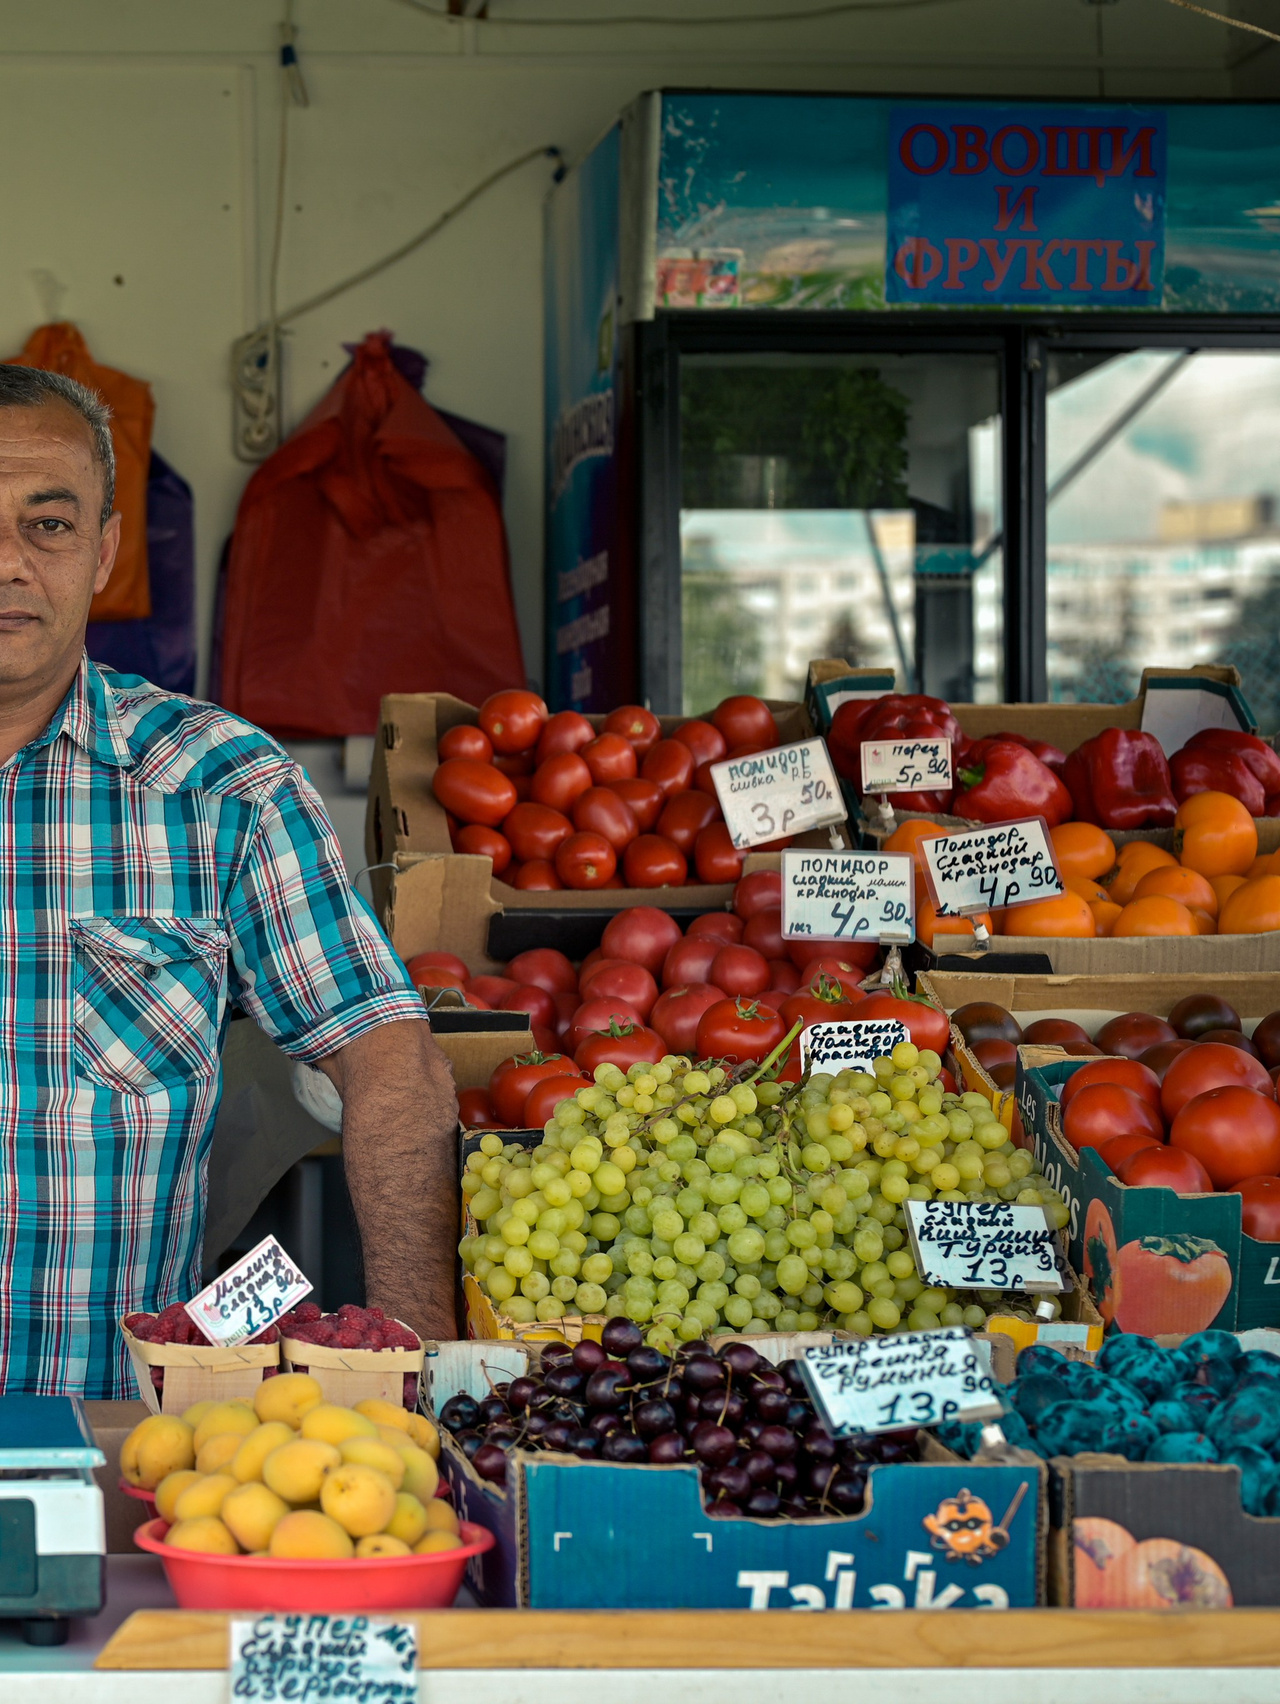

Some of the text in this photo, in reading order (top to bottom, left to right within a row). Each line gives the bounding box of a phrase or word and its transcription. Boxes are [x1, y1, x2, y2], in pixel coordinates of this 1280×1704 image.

[899, 123, 1157, 188] ОВОЩИ
[993, 186, 1039, 231] И
[894, 237, 1156, 292] ФРУКТЫ
[801, 858, 889, 875] ПОМИДОР
[810, 1049, 893, 1065] Краснода
[1021, 1081, 1037, 1122] Les
